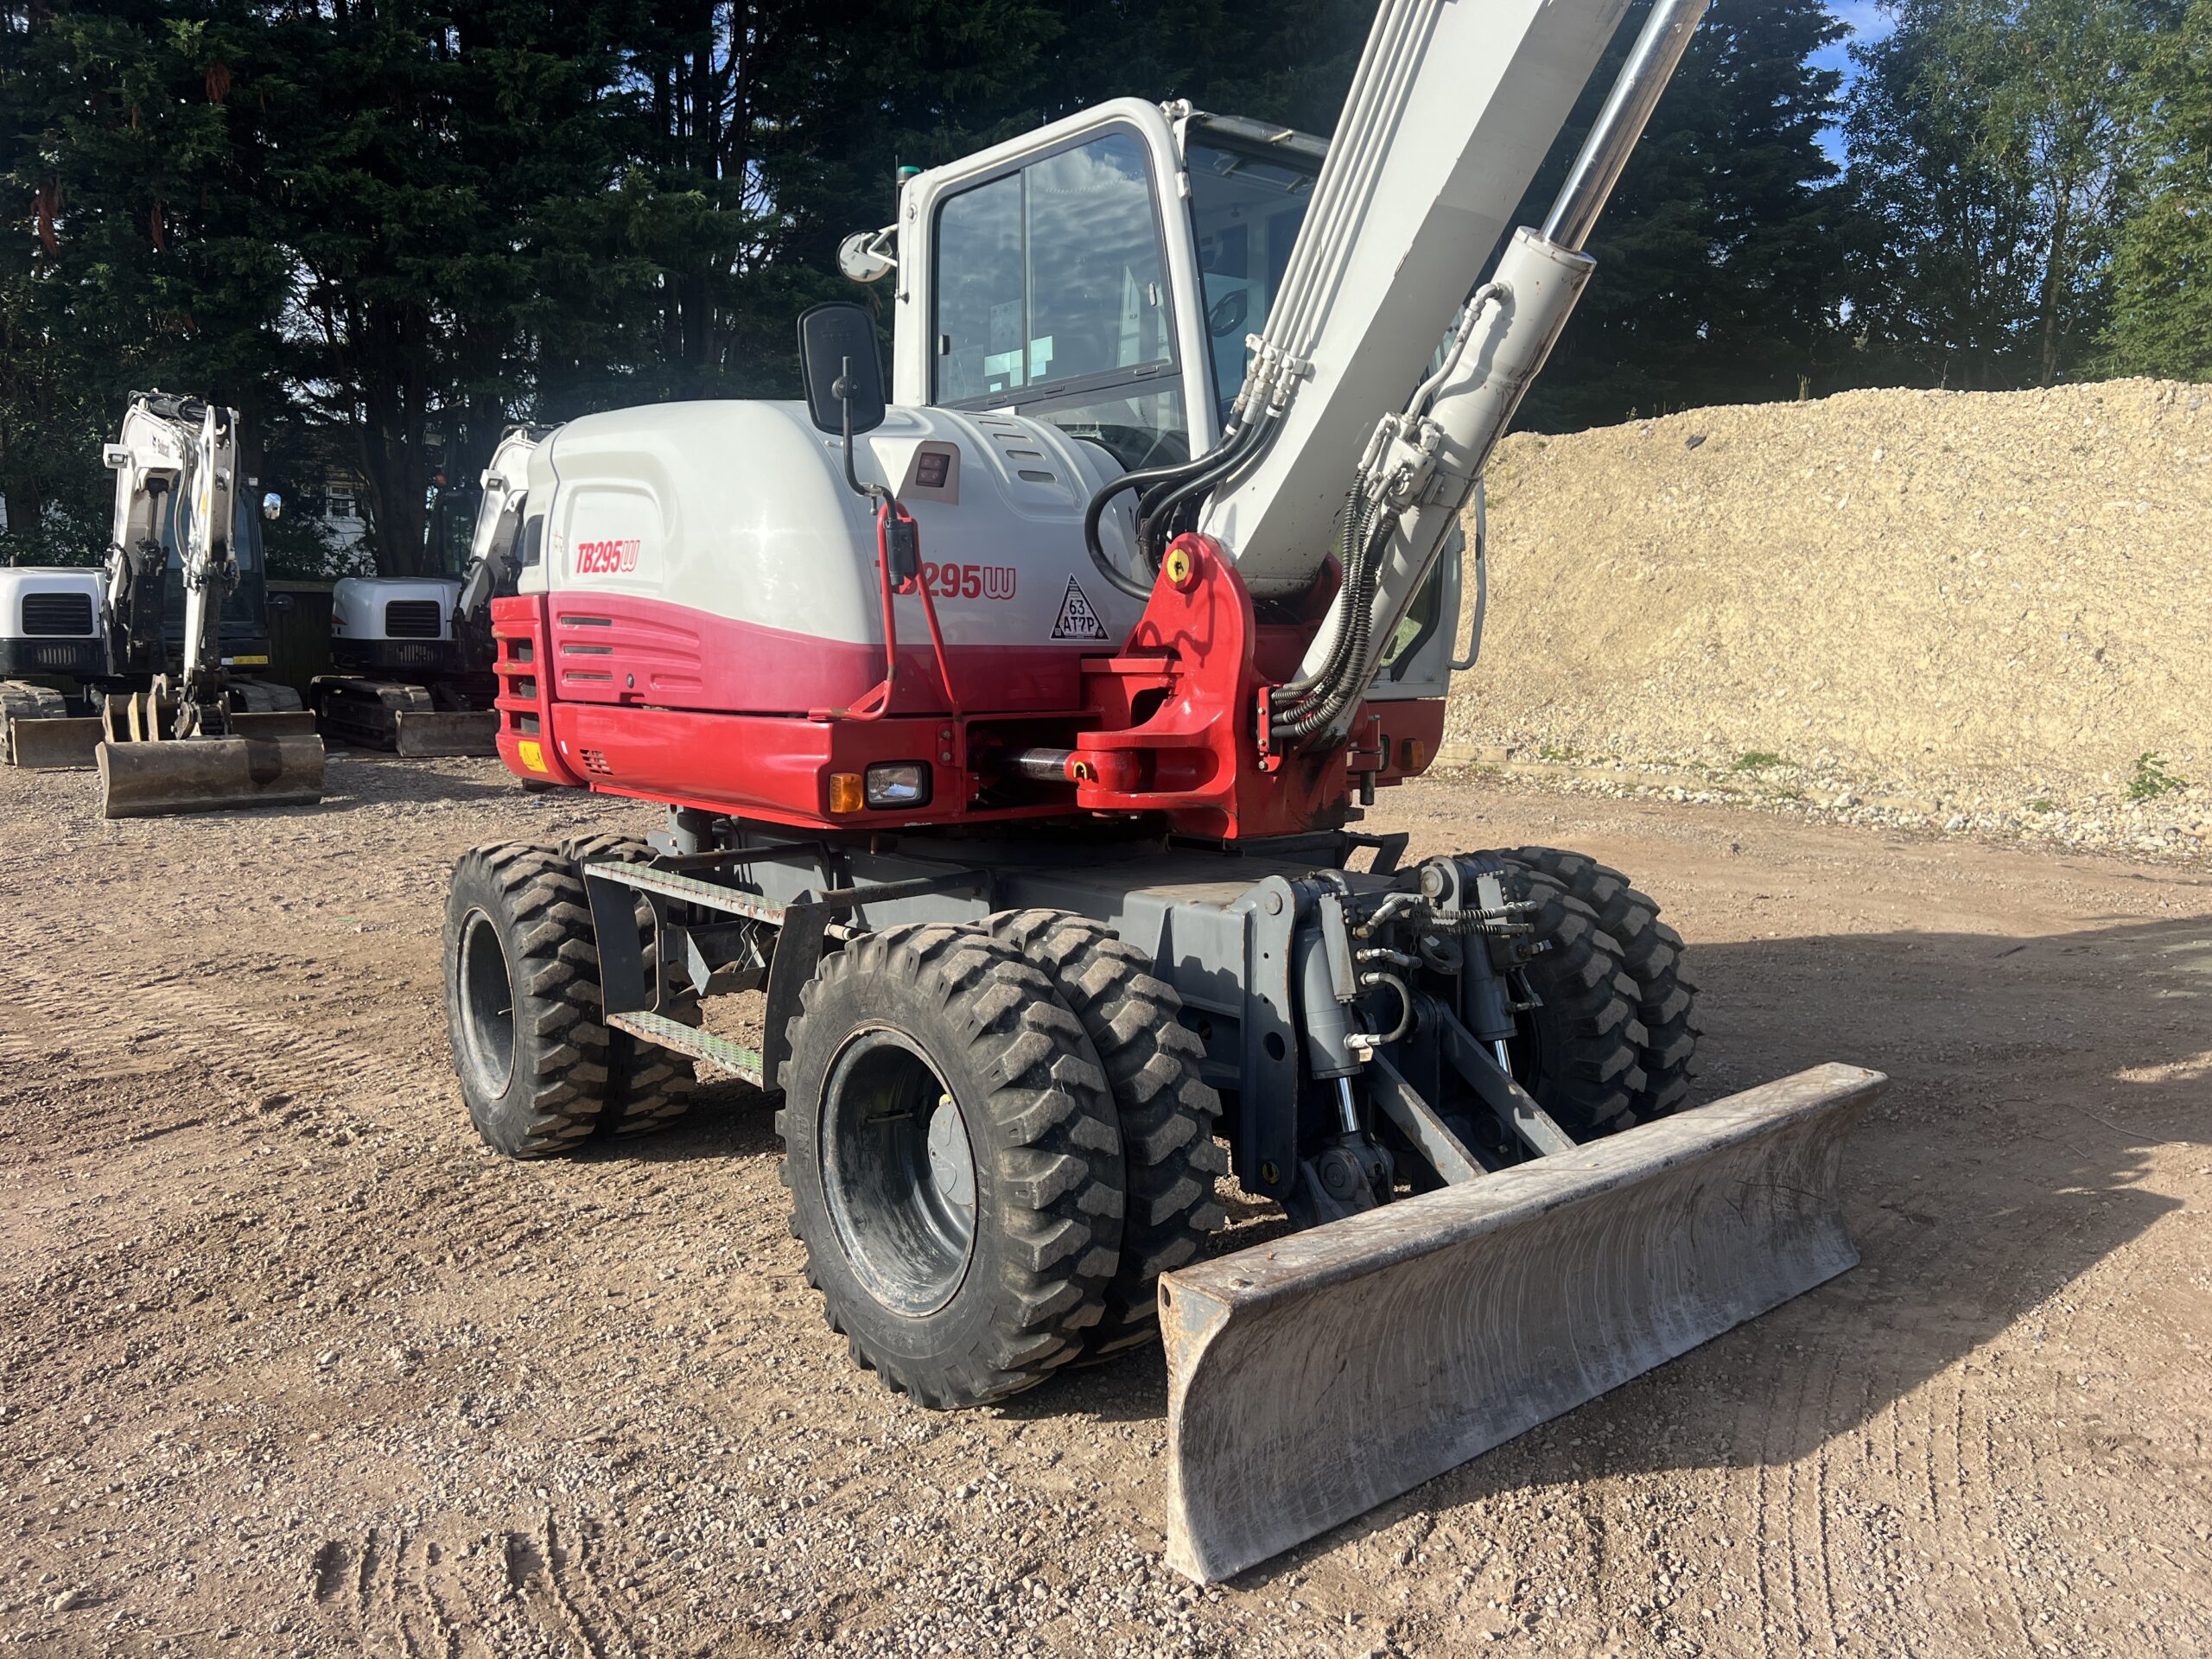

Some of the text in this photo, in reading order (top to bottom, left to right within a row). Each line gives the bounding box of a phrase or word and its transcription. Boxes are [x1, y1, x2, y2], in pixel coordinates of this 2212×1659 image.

[575, 539, 641, 574] TB295W
[874, 560, 1016, 601] 295W
[1069, 599, 1085, 615] 63
[1063, 616, 1095, 632] AT7P
